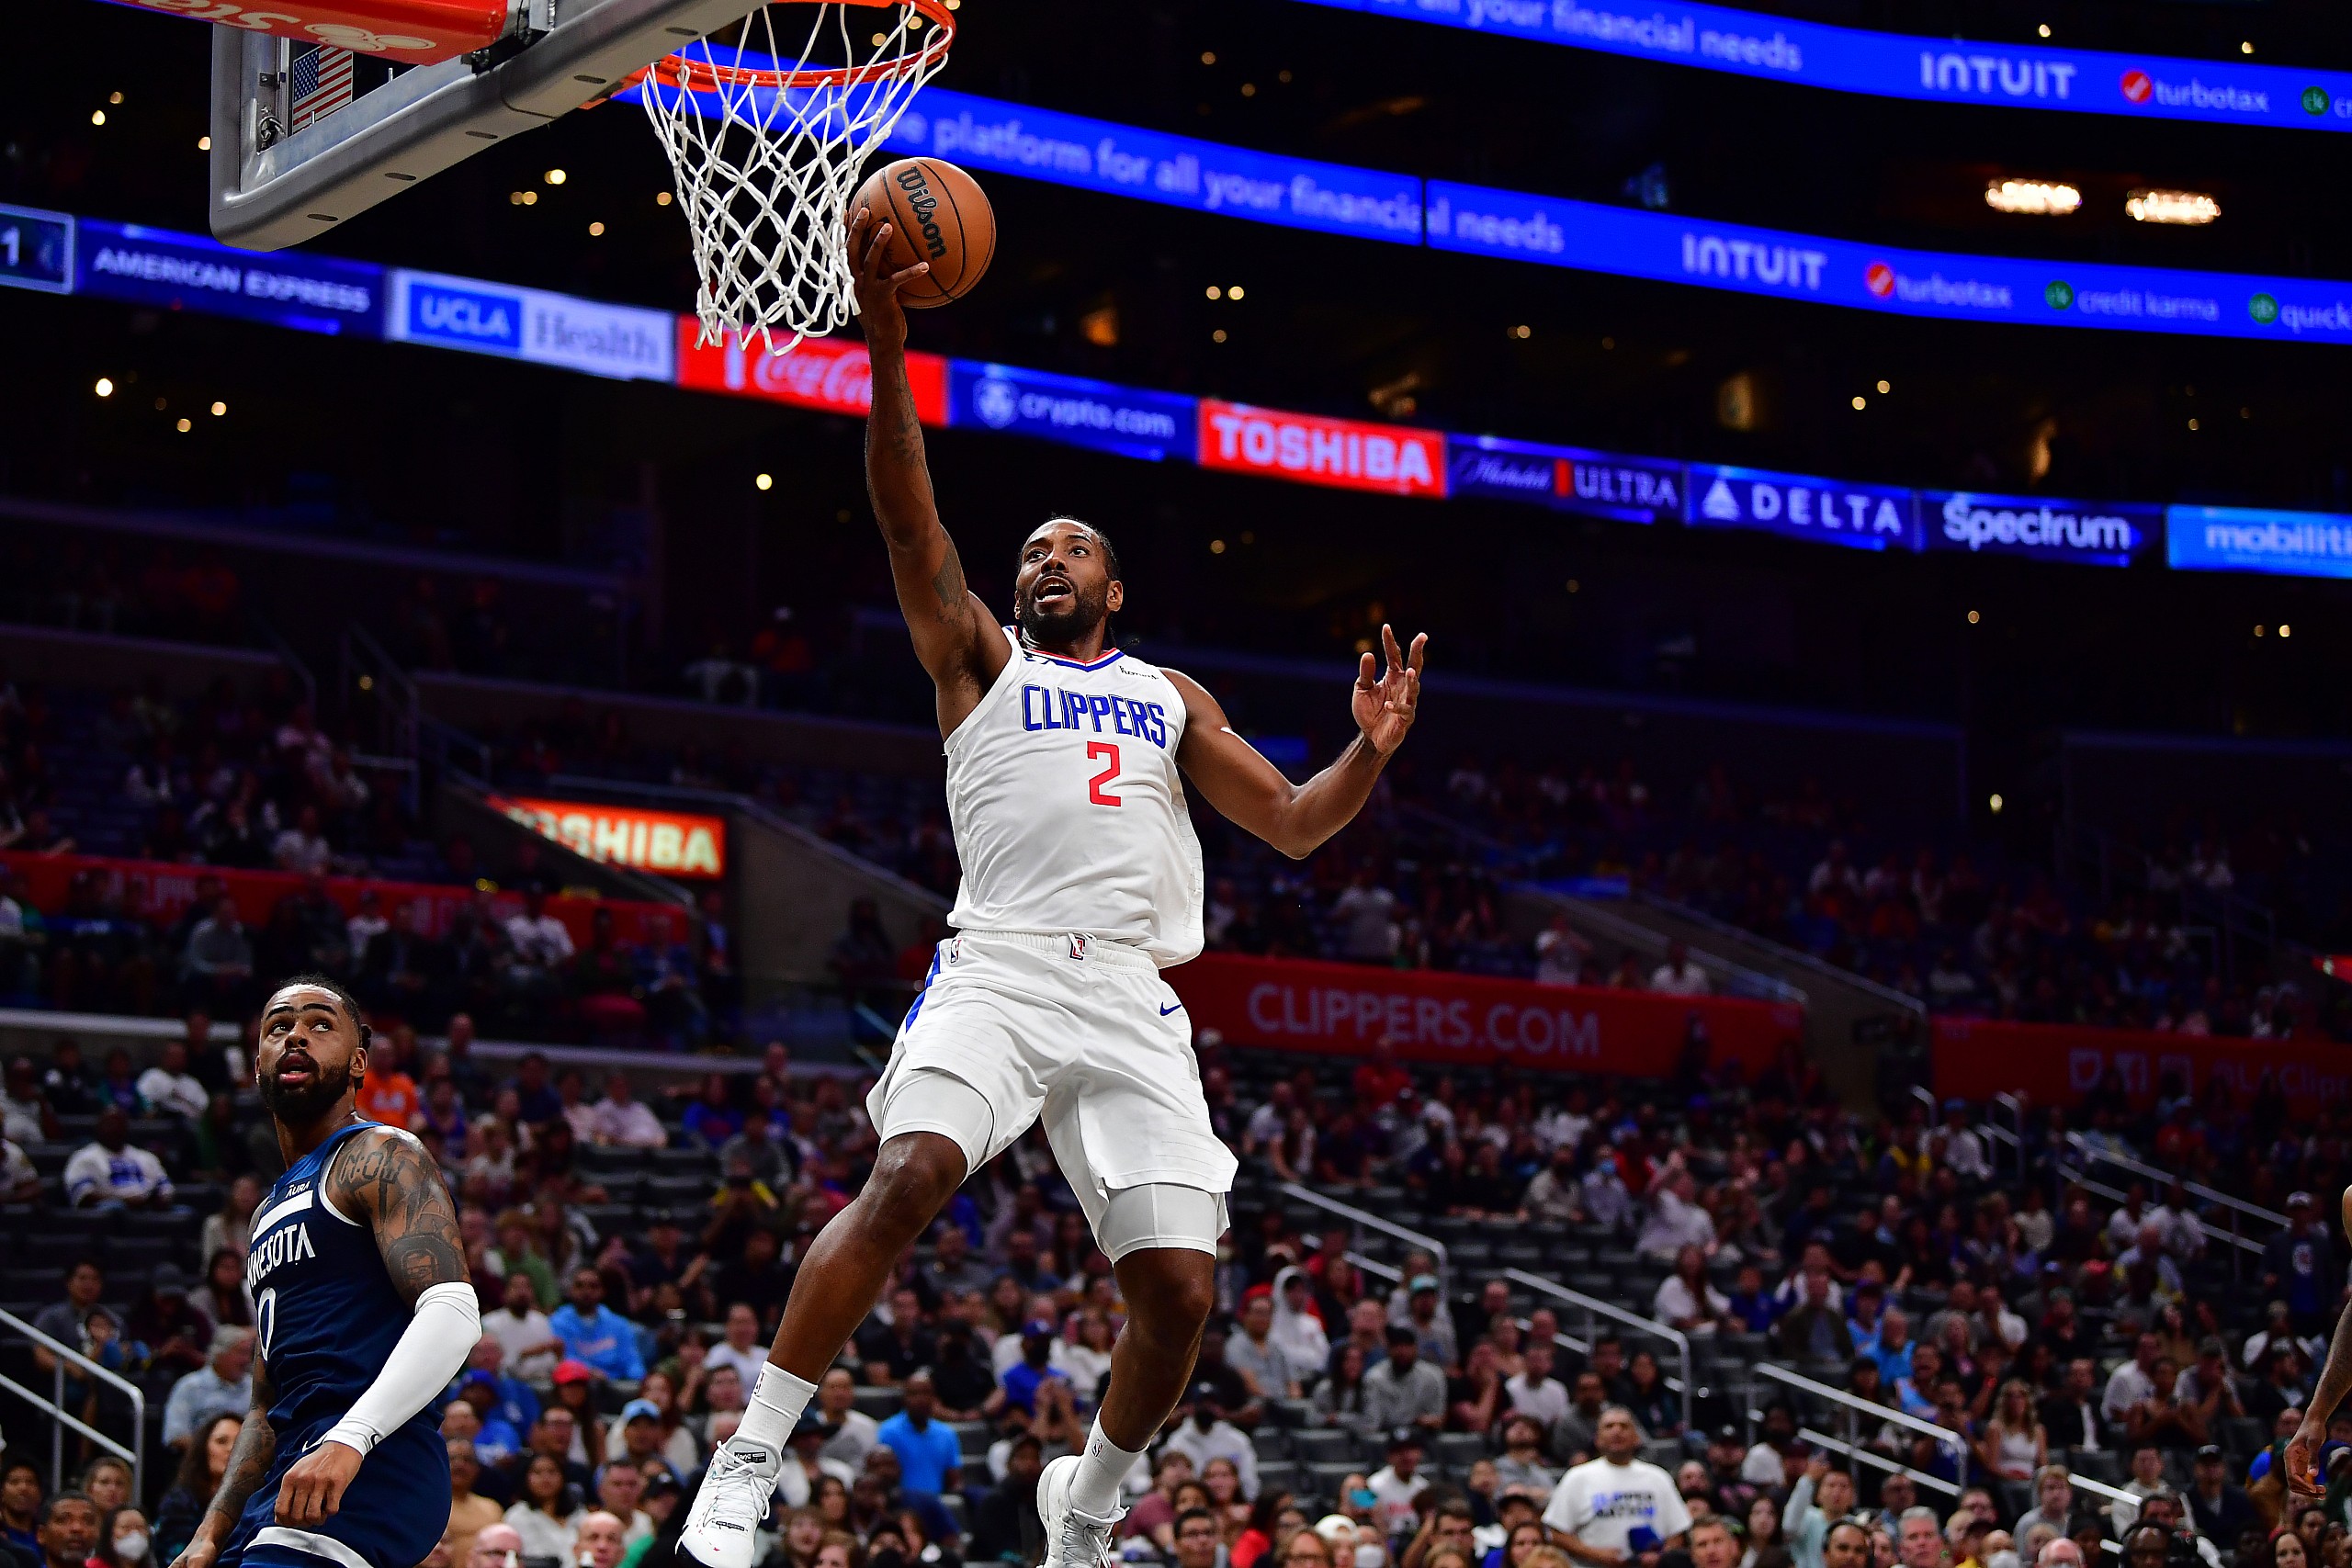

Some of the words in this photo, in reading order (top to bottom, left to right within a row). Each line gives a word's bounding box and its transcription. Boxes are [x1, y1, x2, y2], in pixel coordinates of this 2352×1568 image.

[1552, 0, 1695, 52] financial
[1700, 31, 1803, 72] needs
[1920, 51, 2076, 99] INTUIT
[2154, 77, 2270, 112] turbotax
[895, 165, 948, 261] Wilson
[933, 110, 1092, 175] platform
[1097, 138, 1148, 184] for
[1154, 153, 1199, 195] all
[1204, 171, 1283, 210] your
[1290, 174, 1451, 237] financial
[1455, 209, 1563, 254] needs
[95, 247, 242, 293] AMERICAN
[244, 270, 370, 313] EXPRESS
[1682, 233, 1826, 290] INTUIT
[1895, 273, 2013, 309] turbotax
[420, 295, 512, 338] UCLA
[536, 308, 660, 363] Health
[2076, 288, 2143, 317] credit
[2144, 288, 2220, 321] karma
[1019, 391, 1175, 439] crypto.com
[1211, 413, 1433, 487] TOSHIBA
[1573, 463, 1679, 509] ULTRA
[1750, 482, 1903, 536] DELTA
[1942, 494, 2131, 551] Spectrum
[1022, 683, 1166, 749] CLIPPERS
[1087, 740, 1122, 807] 2
[506, 805, 720, 874] SHIBA
[1248, 982, 1600, 1057] CLIPPERS.COM
[257, 1286, 276, 1360] 0
